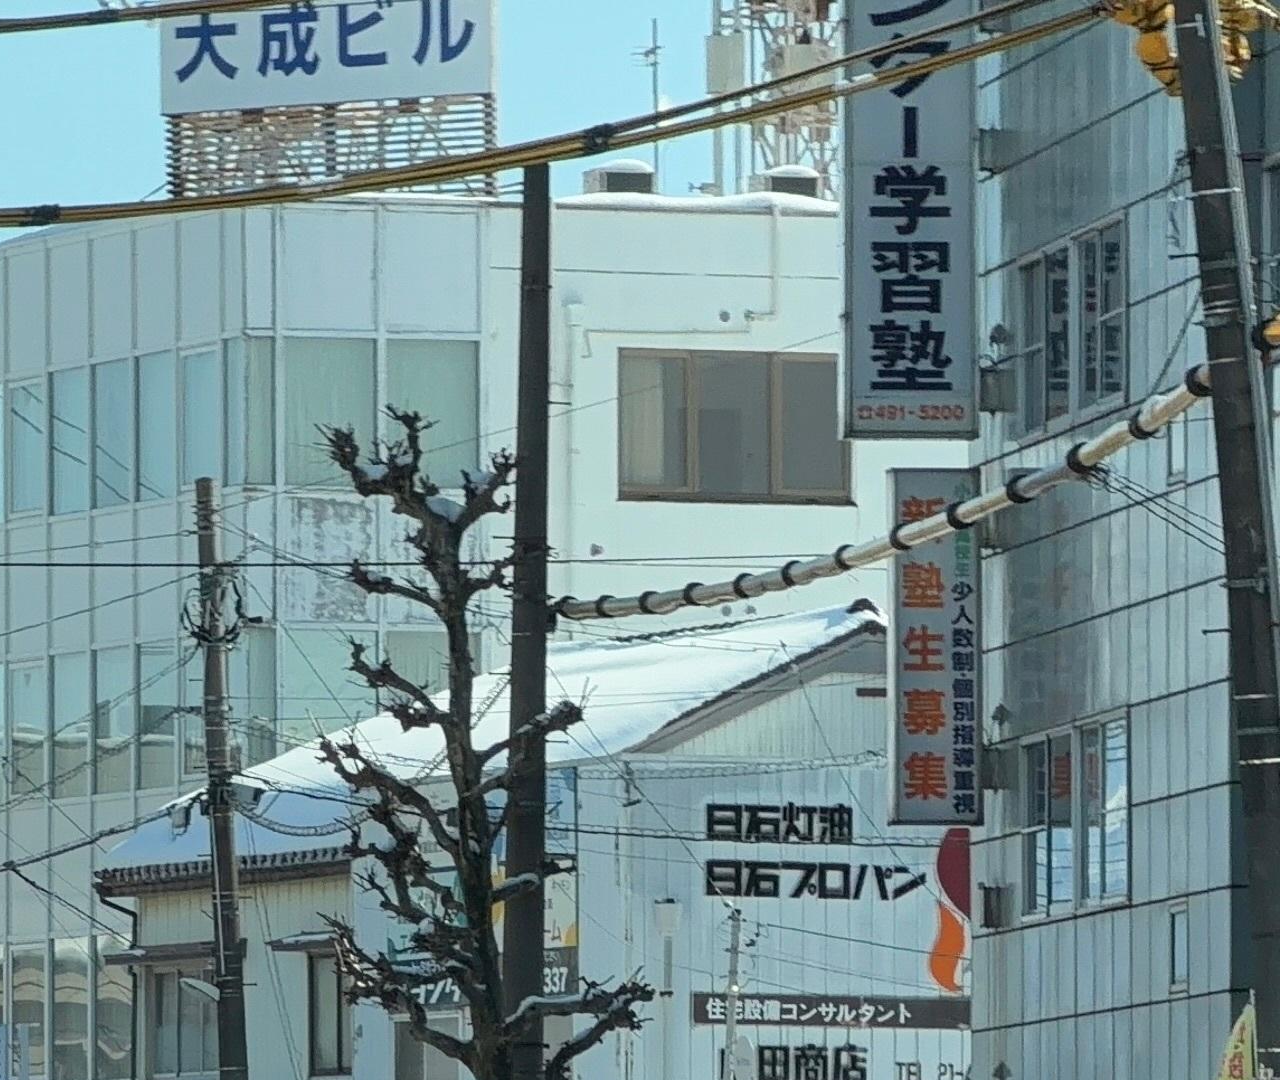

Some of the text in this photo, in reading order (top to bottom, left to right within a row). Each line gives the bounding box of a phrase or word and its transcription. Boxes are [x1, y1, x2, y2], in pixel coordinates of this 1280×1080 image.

[174, 0, 474, 82] 大成ビル
[706, 801, 853, 842] 日石灯油
[705, 859, 927, 900] 日石プロパン
